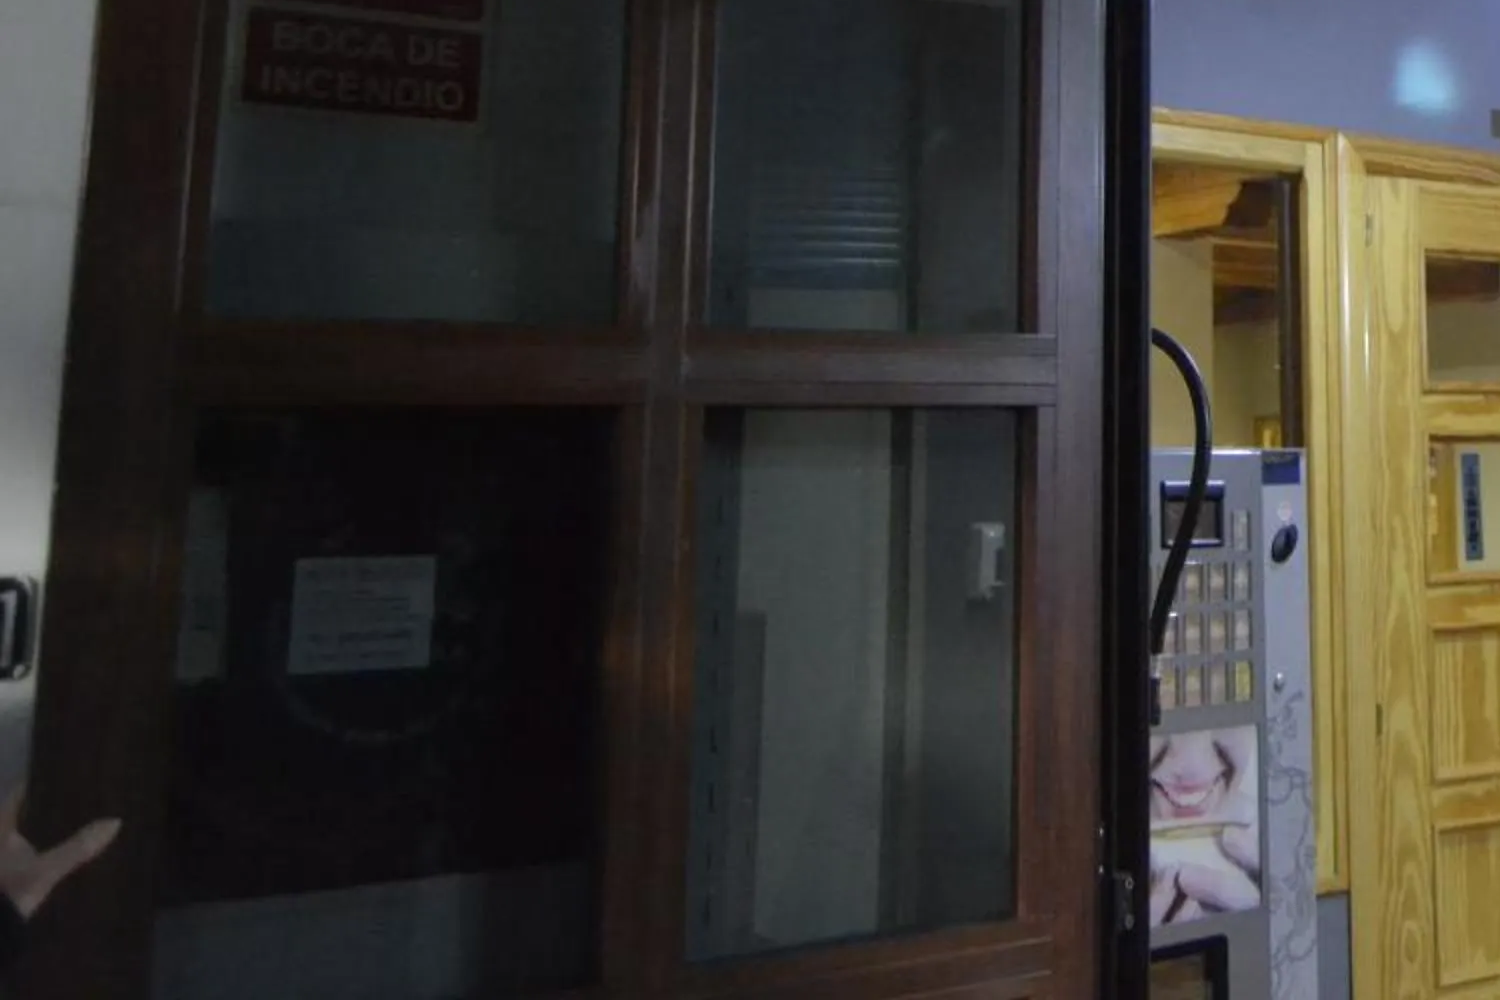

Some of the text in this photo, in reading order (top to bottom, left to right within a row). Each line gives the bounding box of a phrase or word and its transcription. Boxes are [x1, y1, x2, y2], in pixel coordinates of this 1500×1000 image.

[271, 19, 463, 69] BOCA DE
[259, 64, 466, 112] INCENDIO
